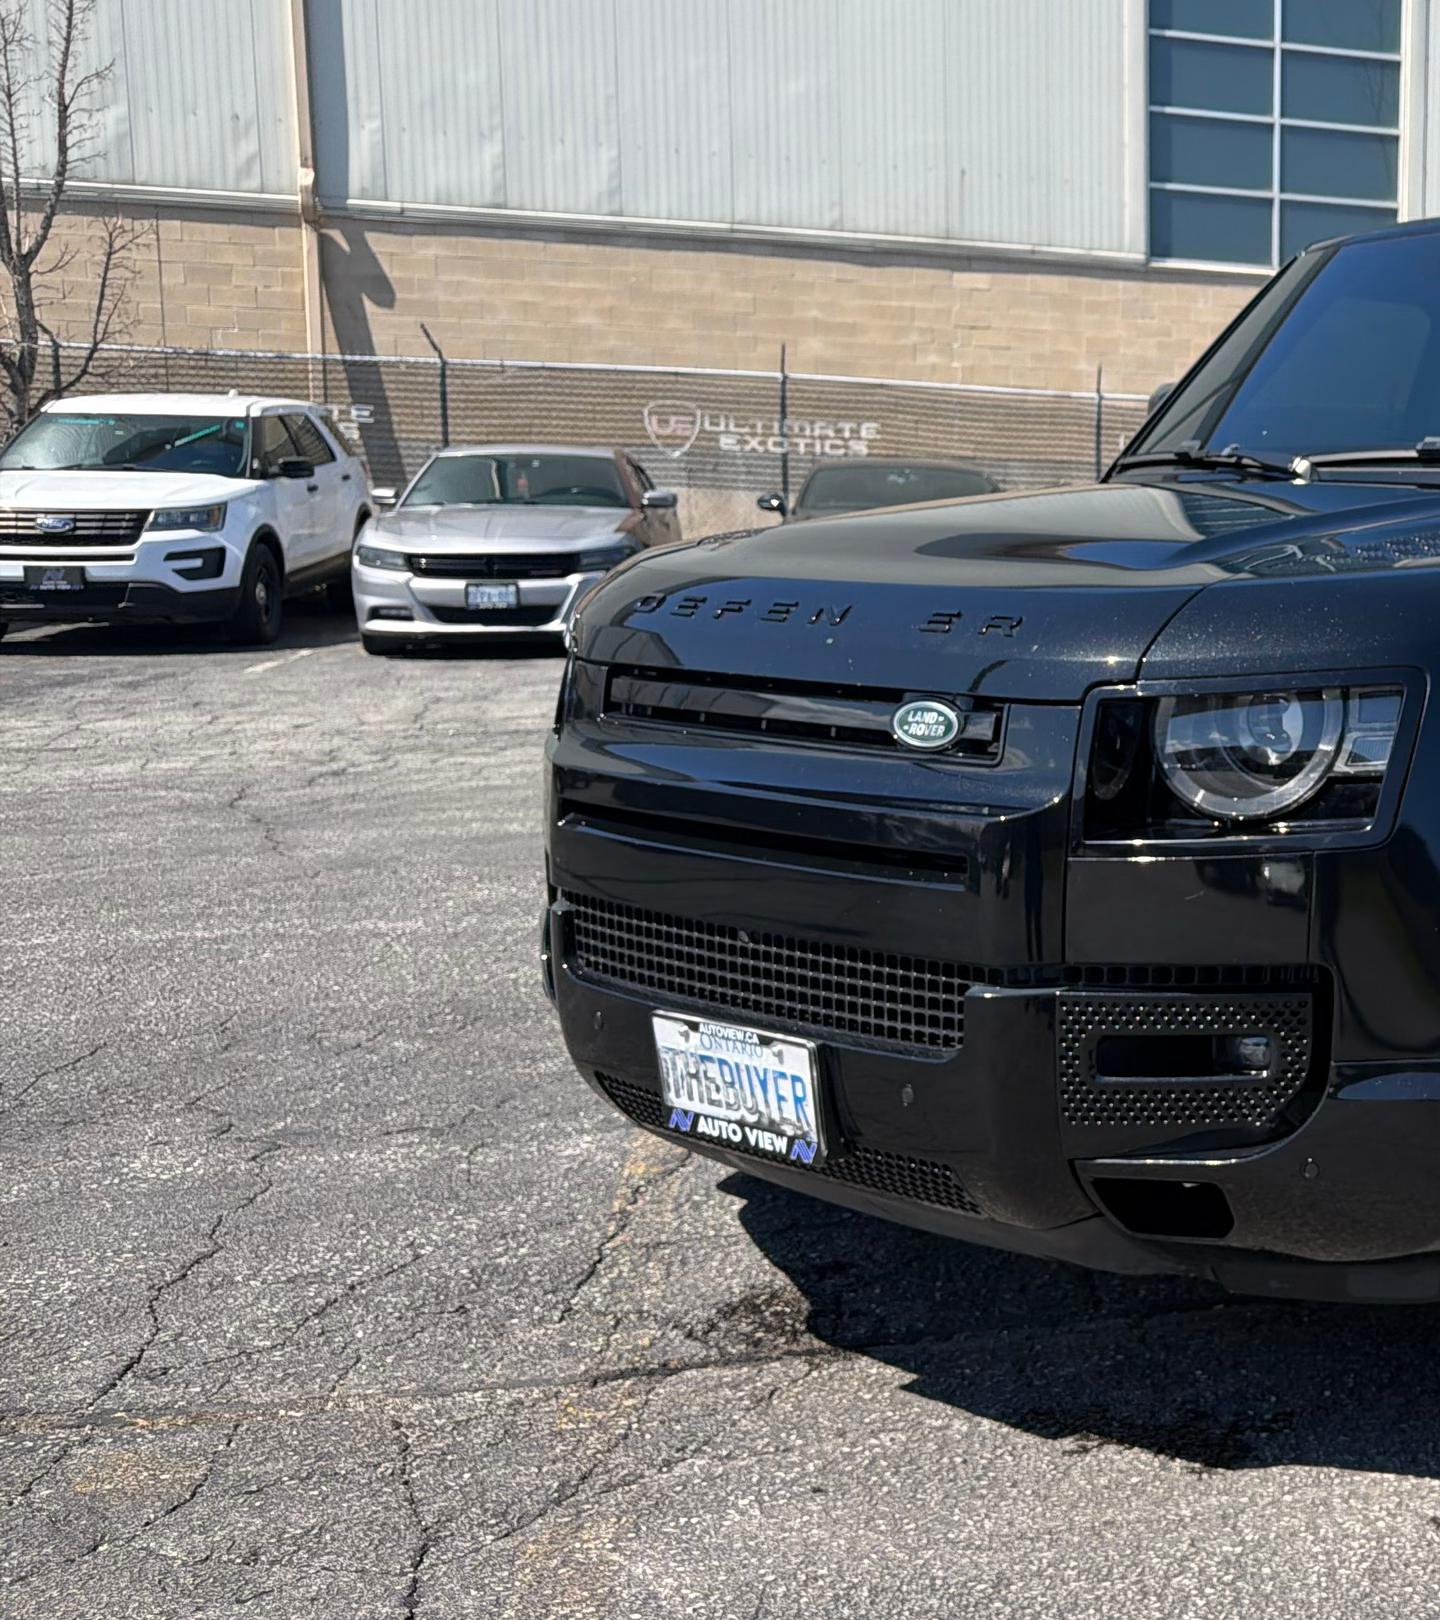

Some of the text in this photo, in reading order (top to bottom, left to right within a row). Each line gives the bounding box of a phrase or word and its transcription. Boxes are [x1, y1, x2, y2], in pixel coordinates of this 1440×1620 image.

[704, 414, 879, 438] ULTIMATE
[719, 434, 868, 456] EXOTICS
[633, 593, 1024, 638] DEFENER
[699, 1023, 760, 1045] AUTOVIEW.CA
[701, 1033, 763, 1058] ONTARIO
[697, 1115, 742, 1143] AUTO
[744, 1126, 788, 1155] VIEW
